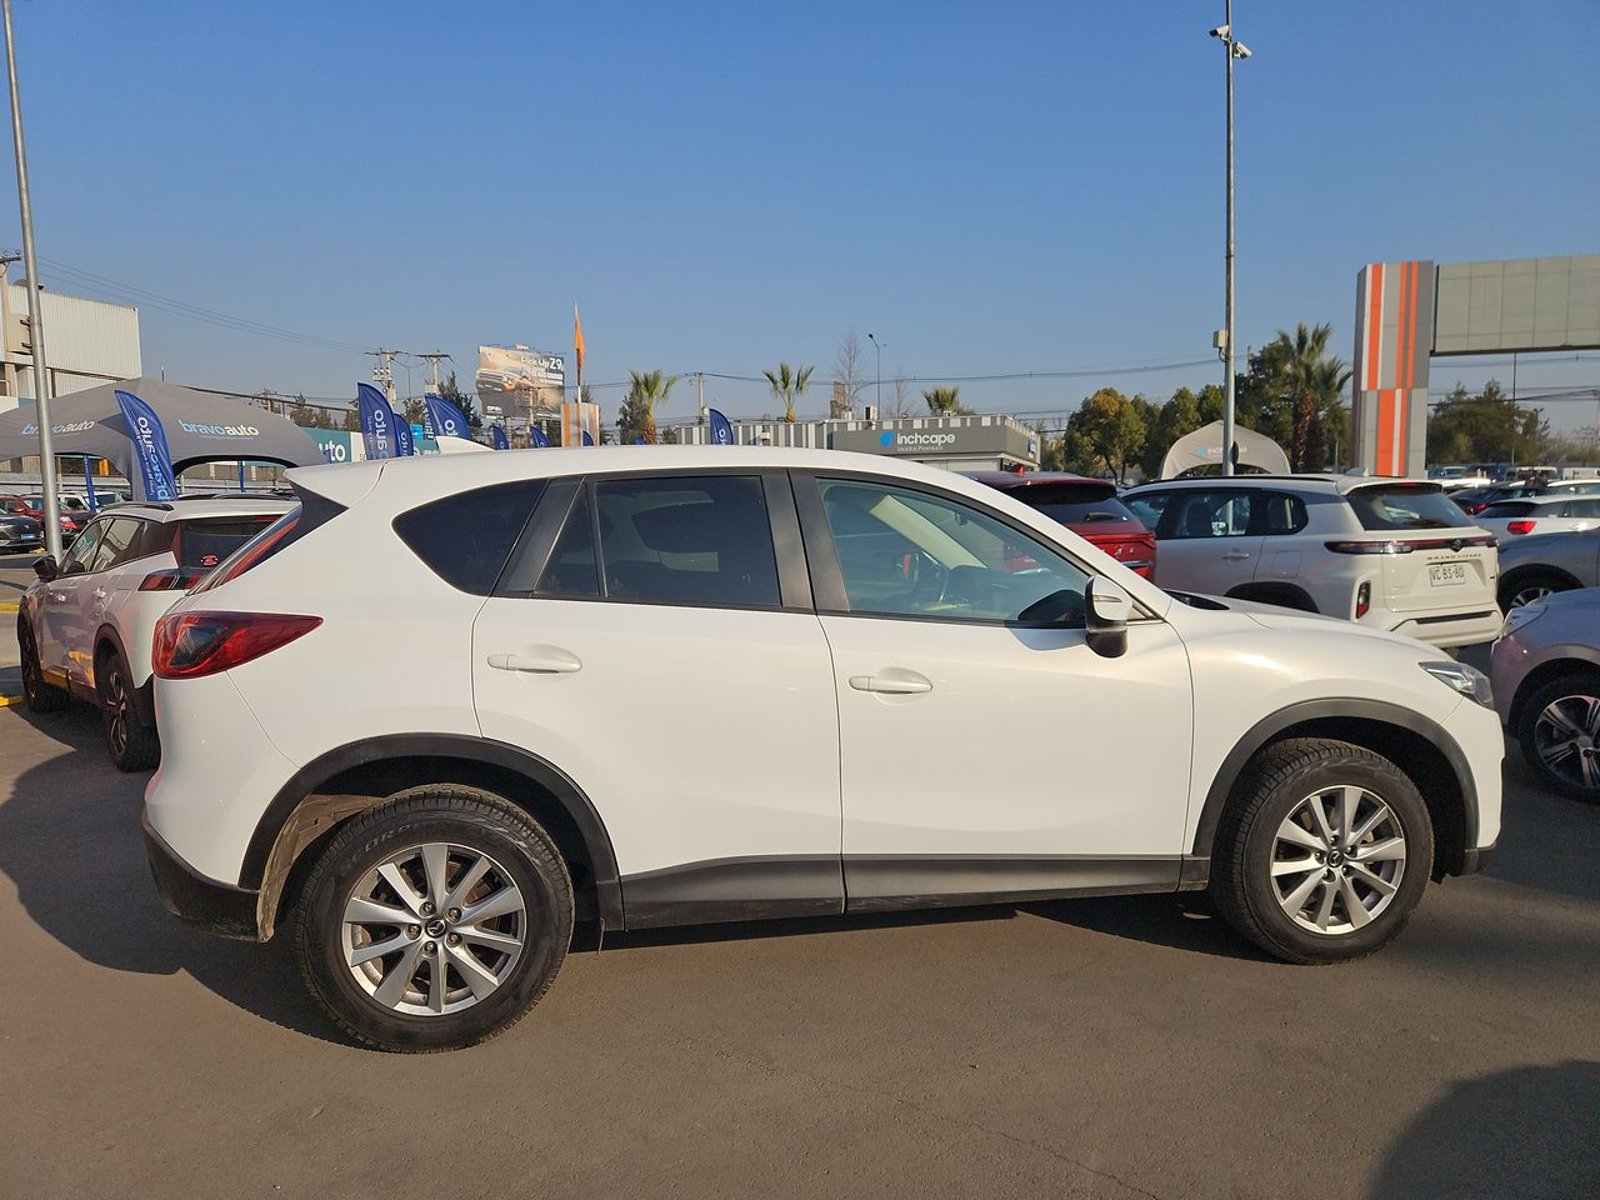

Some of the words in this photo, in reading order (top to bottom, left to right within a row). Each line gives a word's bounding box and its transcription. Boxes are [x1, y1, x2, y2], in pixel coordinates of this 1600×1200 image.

[549, 357, 562, 370] Z9
[178, 418, 260, 436] bravoauto
[897, 432, 956, 446] inchcape
